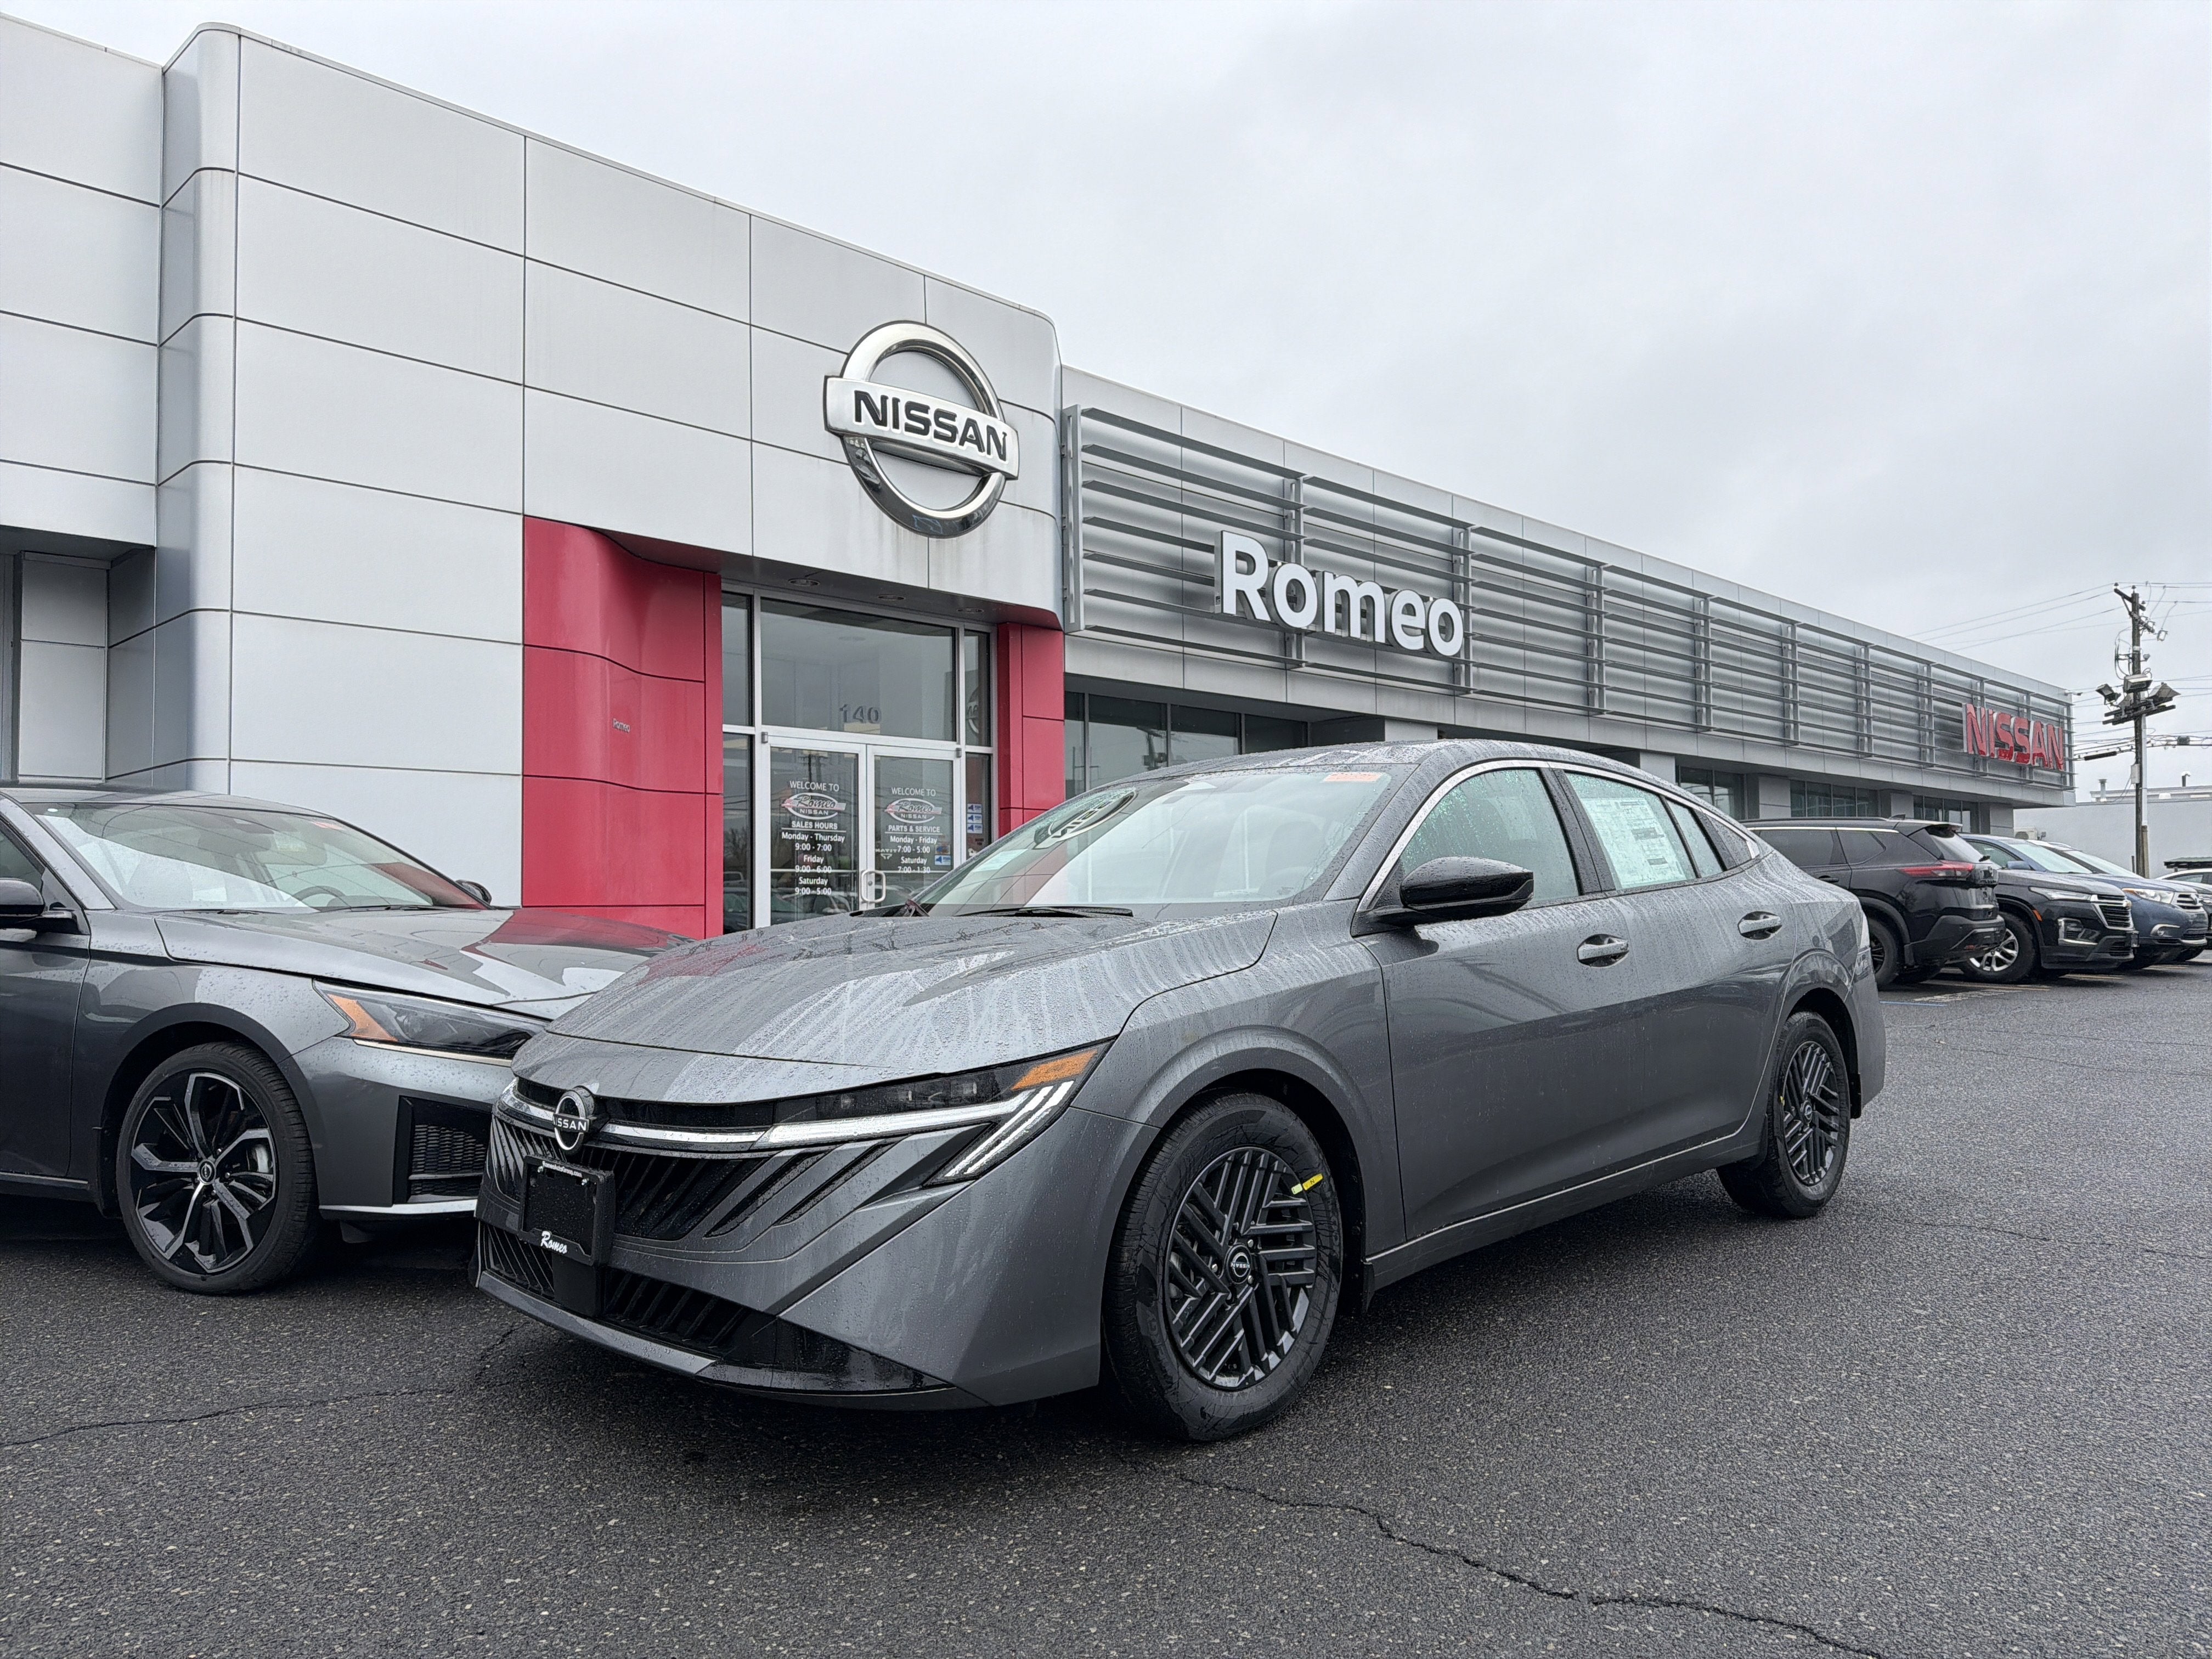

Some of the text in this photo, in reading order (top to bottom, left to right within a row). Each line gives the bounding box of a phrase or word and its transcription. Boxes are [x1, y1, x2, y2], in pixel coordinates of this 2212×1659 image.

[854, 390, 1008, 462] NISSAN
[1219, 530, 1464, 657] Romeo
[839, 704, 881, 724] 140
[1963, 703, 2064, 771] NISSAN
[789, 781, 839, 792] WELCOME TO
[891, 787, 936, 797] WELCOME TO
[793, 794, 836, 808] Romeo
[898, 800, 933, 812] Romeo
[781, 832, 809, 842] Monday
[814, 833, 845, 843] Thursday
[890, 835, 914, 844] Monday
[919, 836, 938, 845] Friday
[803, 855, 825, 864] Friday
[901, 856, 927, 865] Saturday
[799, 877, 828, 885] Saturday
[540, 1231, 567, 1254] Romeo
